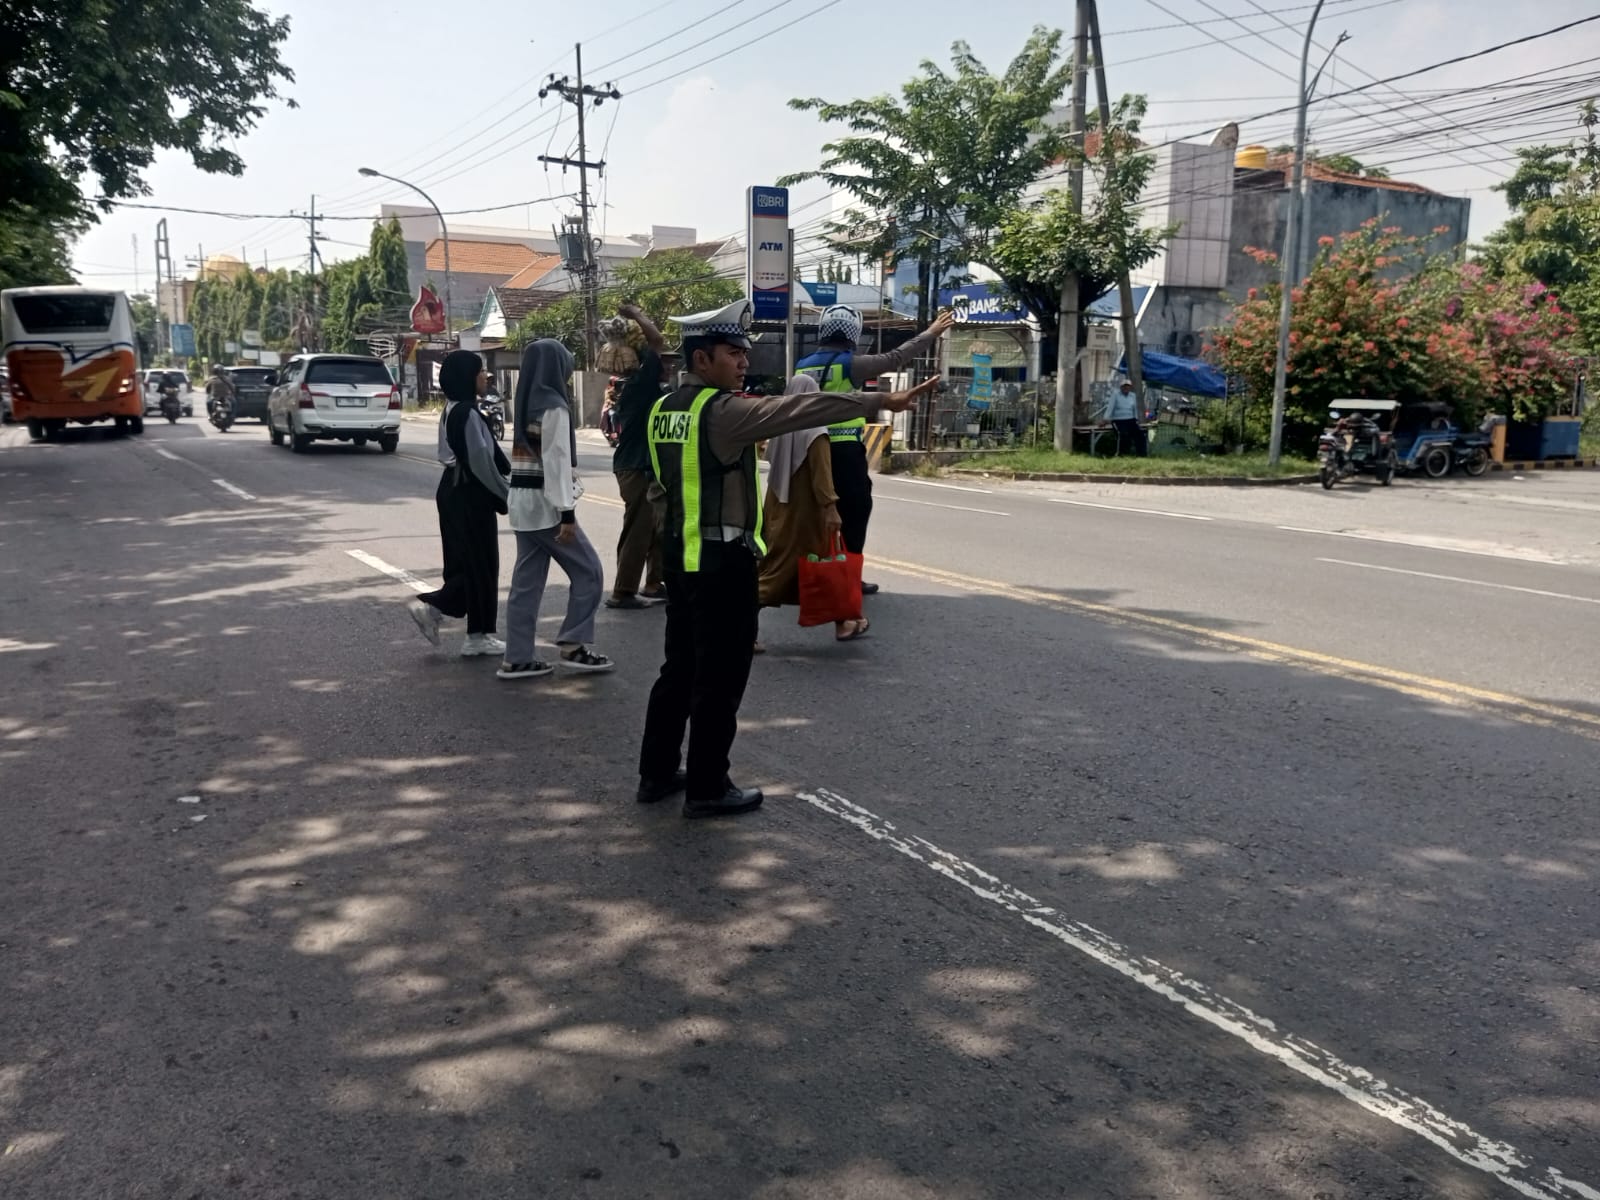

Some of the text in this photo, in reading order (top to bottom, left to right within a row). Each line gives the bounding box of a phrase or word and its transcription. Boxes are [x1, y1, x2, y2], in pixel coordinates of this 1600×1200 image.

[768, 196, 784, 207] BRI
[759, 242, 783, 251] ATM
[969, 297, 1001, 315] BANK
[652, 413, 691, 440] POLISI
